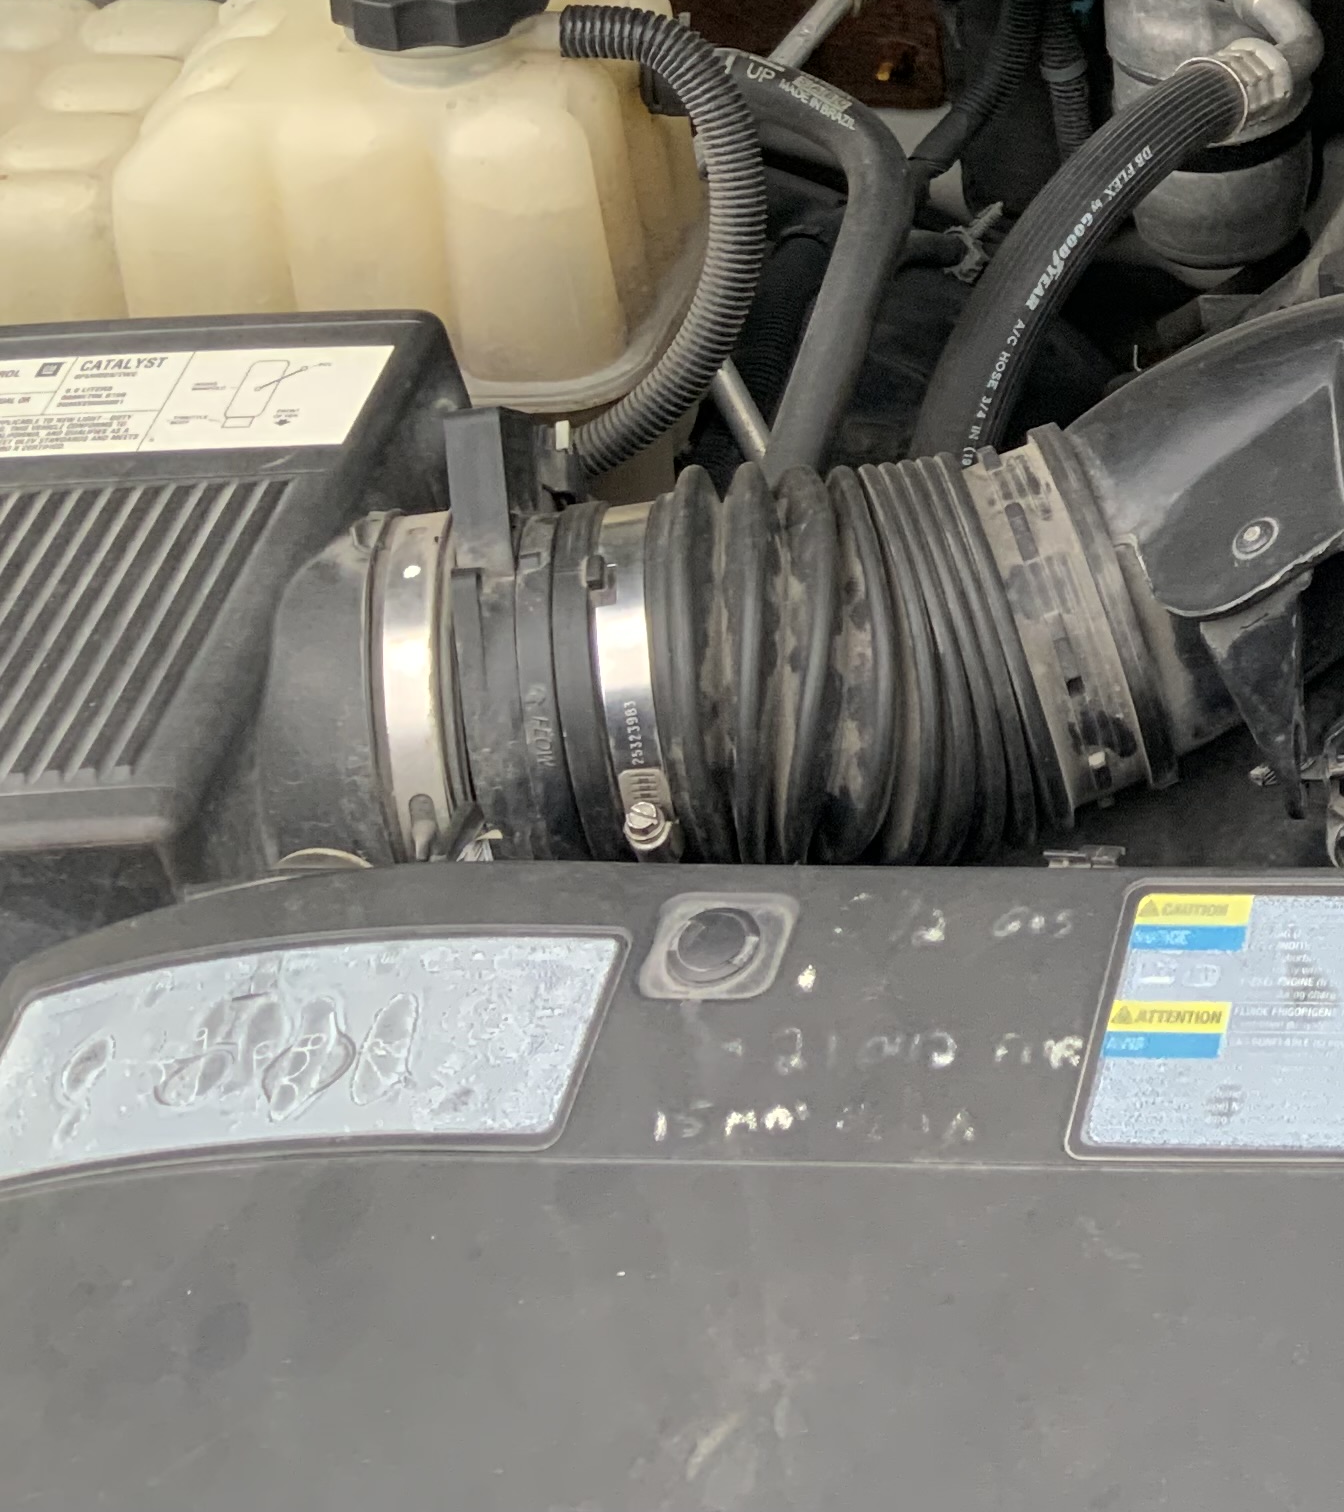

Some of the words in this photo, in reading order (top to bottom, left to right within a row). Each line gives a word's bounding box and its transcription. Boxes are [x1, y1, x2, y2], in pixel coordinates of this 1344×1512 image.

[1134, 145, 1153, 167] DB
[1103, 162, 1136, 201] FLEX
[1025, 212, 1093, 311] GOODYEAR
[1007, 318, 1026, 346] A/C
[79, 357, 168, 372] CATALYST
[986, 351, 1011, 390] HOSE
[976, 395, 992, 418] 3/4
[968, 425, 981, 440] IN
[623, 700, 645, 766] 25323983
[1161, 903, 1229, 917] CAUTION
[1134, 1009, 1223, 1025] ATTENTION
